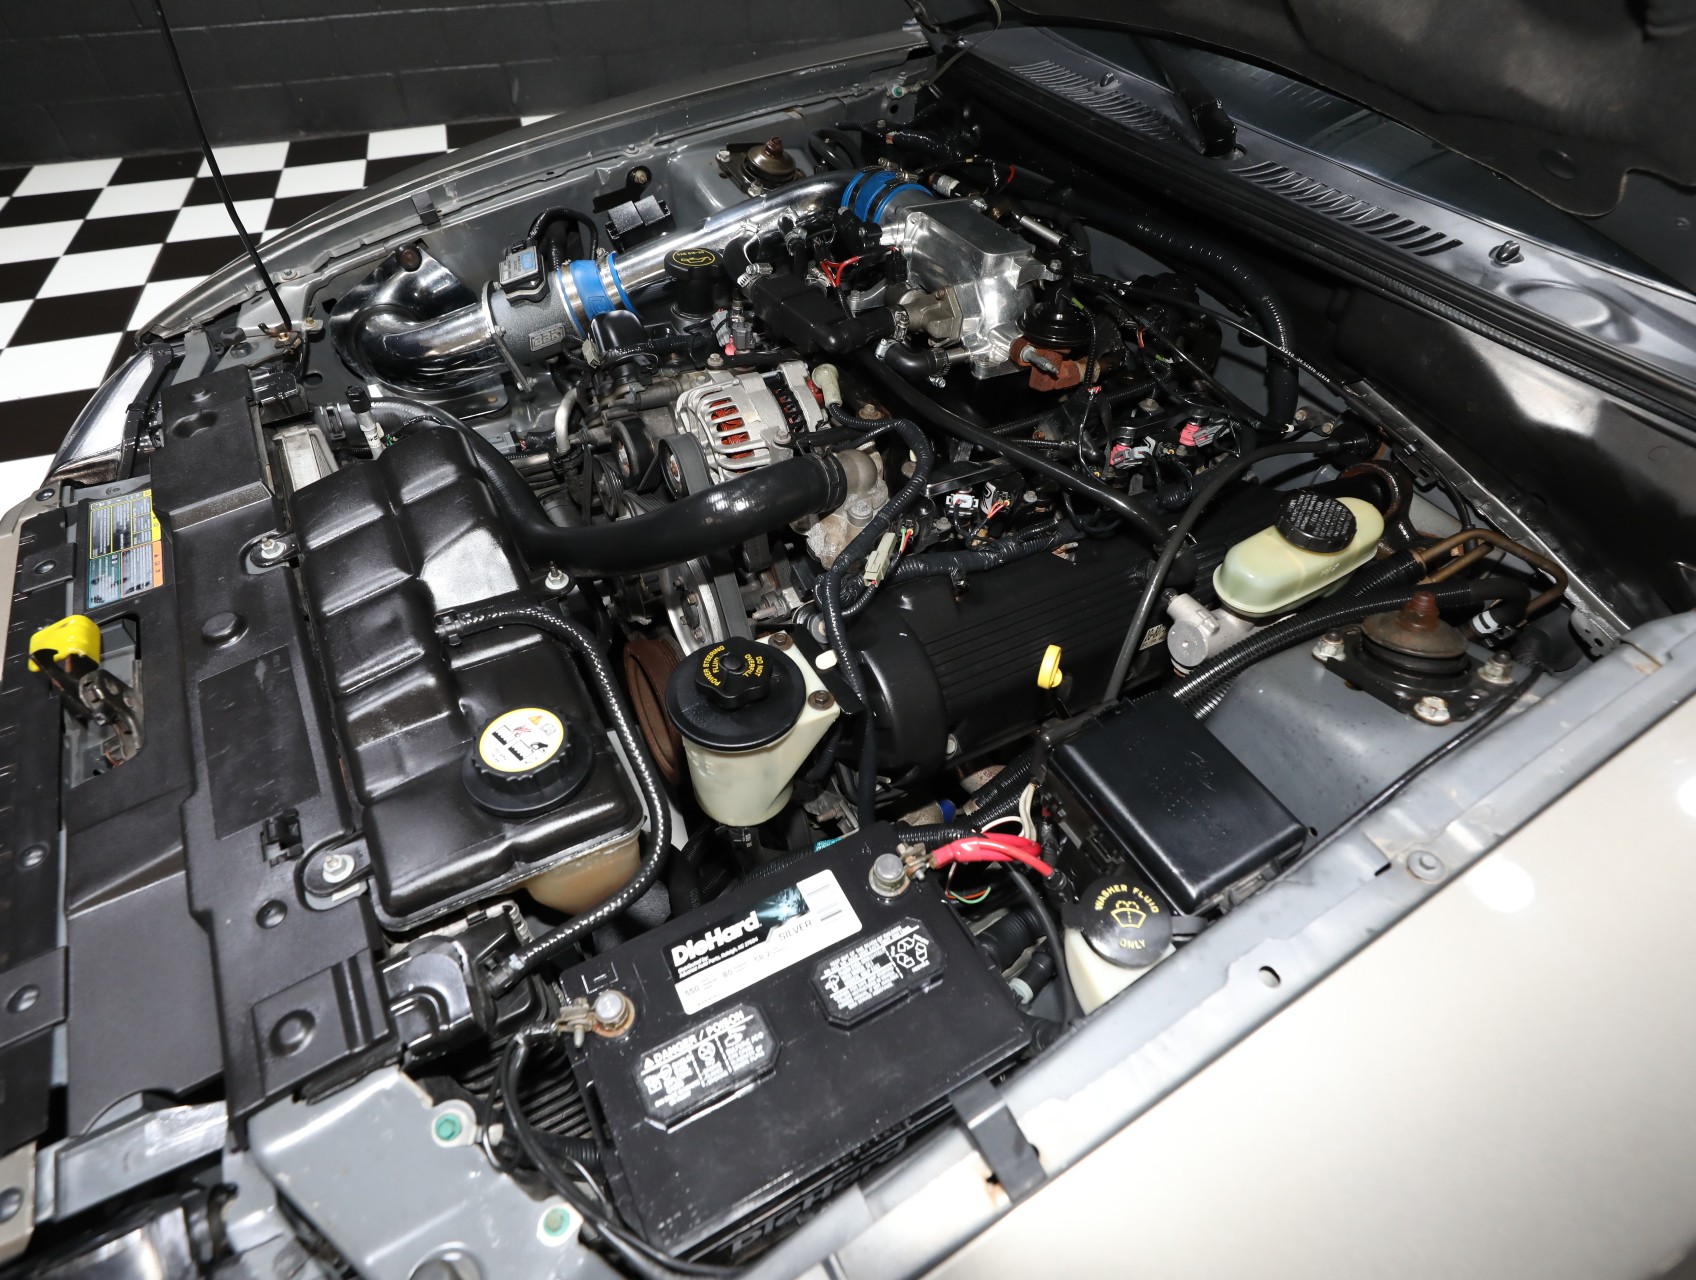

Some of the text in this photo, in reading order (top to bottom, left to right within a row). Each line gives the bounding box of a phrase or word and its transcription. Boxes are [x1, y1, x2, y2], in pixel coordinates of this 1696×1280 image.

[702, 645, 725, 686] POWER STEERING
[711, 657, 719, 673] FLUID
[742, 653, 756, 677] OVERFILL
[755, 656, 764, 677] DO NOT
[1094, 883, 1160, 913] WASHER FLUID
[670, 910, 760, 967] DieHard
[778, 918, 813, 941] SILVER
[1119, 938, 1146, 950] ONLY
[653, 1034, 698, 1064] DANGER
[705, 1010, 745, 1037] POISON
